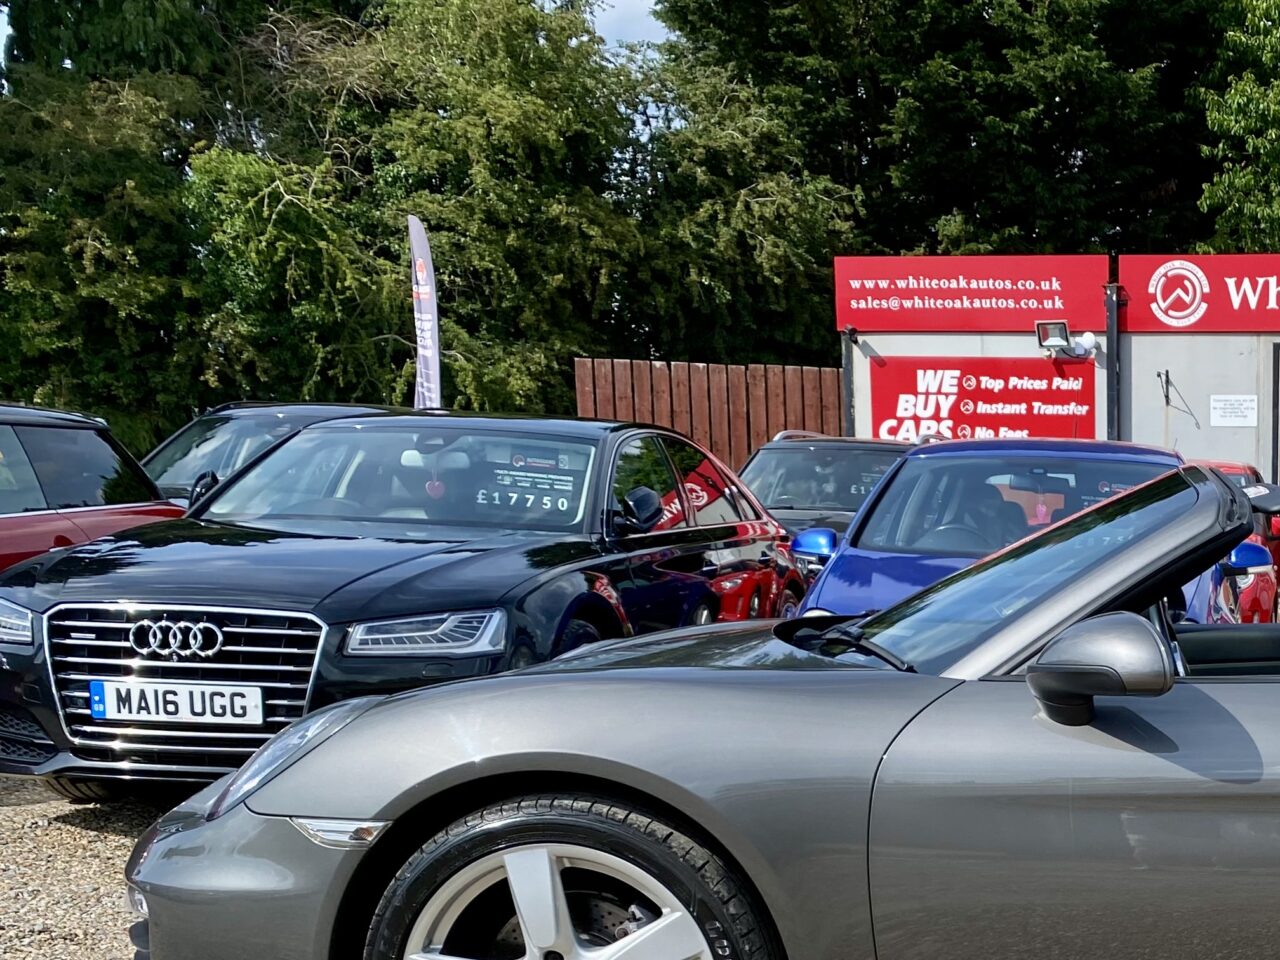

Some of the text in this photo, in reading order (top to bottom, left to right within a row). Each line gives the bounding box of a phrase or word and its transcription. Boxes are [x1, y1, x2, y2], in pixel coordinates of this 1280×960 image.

[849, 276, 1062, 291] www.whiteoakautos.co.uk
[850, 295, 1064, 310] sales@whiteoakautos.co.uk
[916, 370, 960, 393] WE
[979, 376, 1082, 392] Top Prices Paid
[896, 394, 957, 418] BUY
[976, 402, 1089, 416] Instant Transfer
[879, 419, 953, 442] CARS
[974, 426, 995, 438] No
[476, 489, 568, 511] £17750
[115, 687, 247, 718] MA16 UGG
